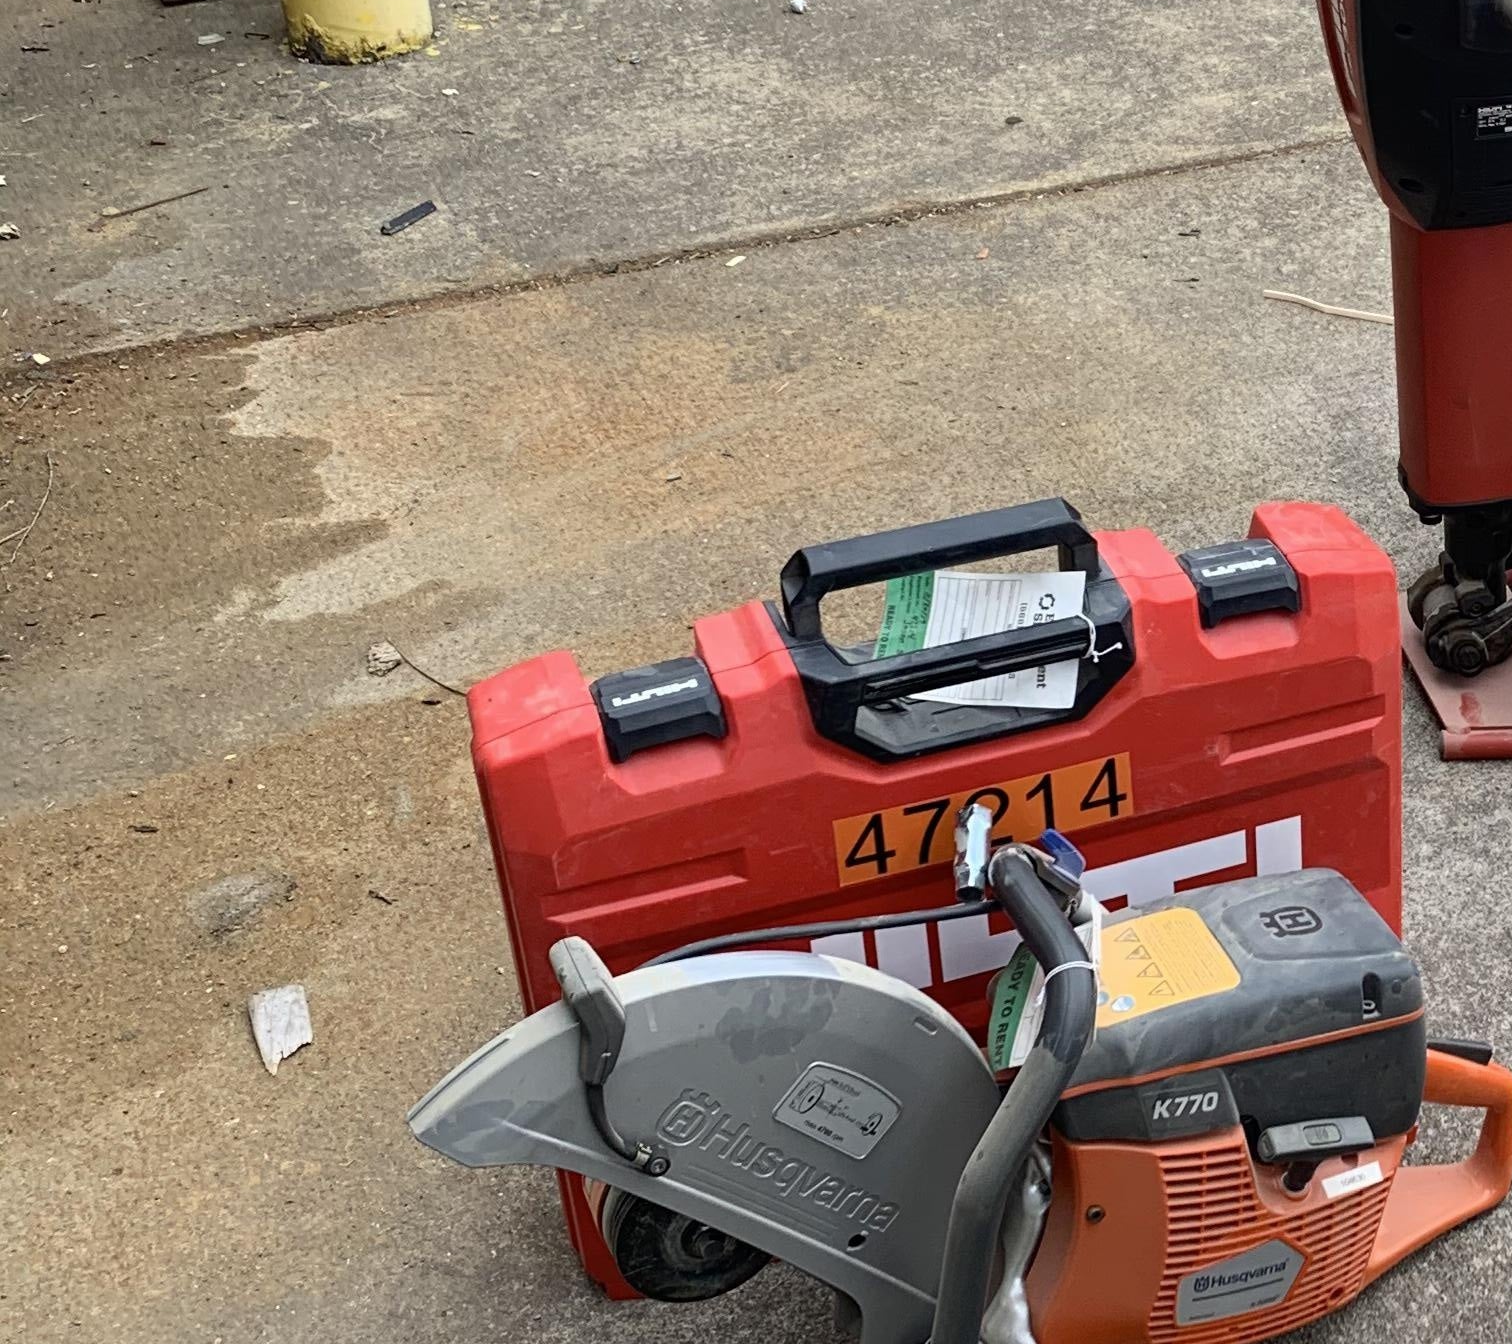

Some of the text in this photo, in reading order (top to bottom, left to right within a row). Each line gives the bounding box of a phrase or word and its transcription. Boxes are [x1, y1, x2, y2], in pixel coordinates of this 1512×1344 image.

[810, 814, 1303, 990] ILTI
[993, 1020, 1009, 1065] RENT
[1001, 996, 1017, 1019] TO
[698, 1112, 901, 1233] Husqvarna
